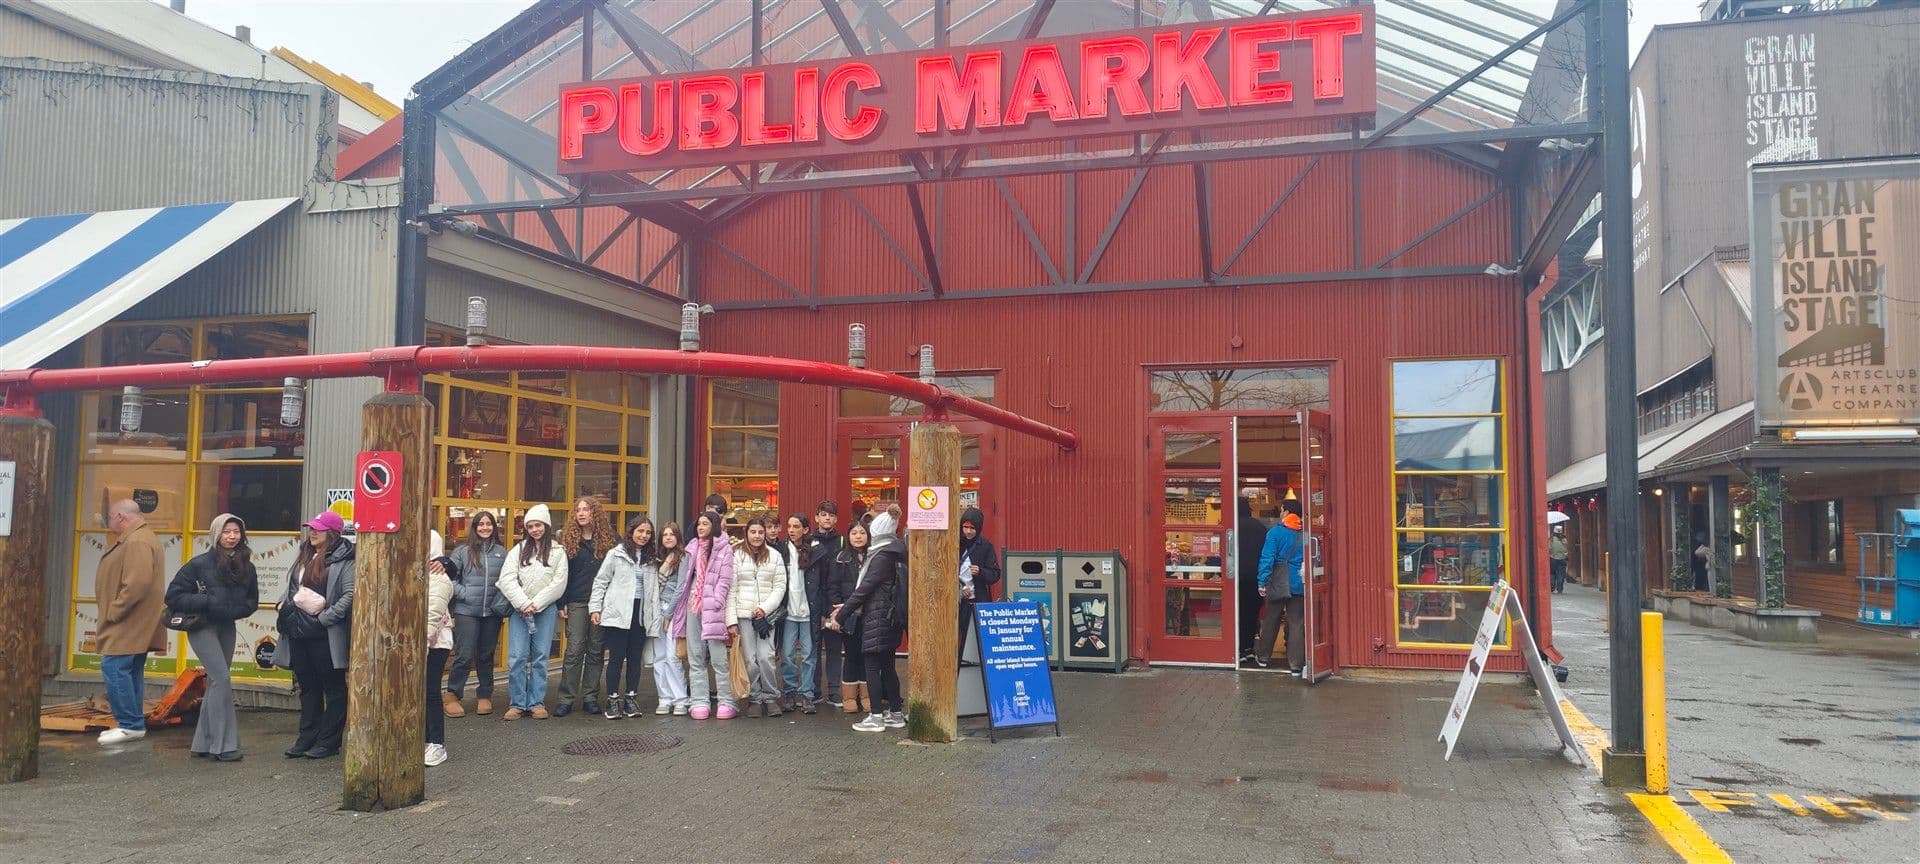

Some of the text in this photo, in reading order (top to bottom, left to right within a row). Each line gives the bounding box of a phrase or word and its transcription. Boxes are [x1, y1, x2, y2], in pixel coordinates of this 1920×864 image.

[561, 13, 1363, 160] PUBLIC MARKET
[1746, 62, 1817, 94] VILLE
[1747, 91, 1817, 119] ISLAND
[1746, 116, 1817, 145] STAGE
[1779, 179, 1875, 218] GRAN
[1781, 217, 1877, 259] VILLE
[1782, 258, 1878, 295] ISLAND
[1783, 295, 1879, 332] STAGE
[1831, 369, 1917, 380] ARTSCLUB
[1831, 384, 1918, 395] THEATRE
[1832, 400, 1918, 410] COMPANY
[979, 608, 1038, 617] The Public Market
[980, 616, 1040, 626] is closed Mondays
[989, 626, 997, 635] in
[1023, 625, 1033, 633] for
[1001, 635, 1025, 643] annual
[991, 644, 1037, 652] maintenance.
